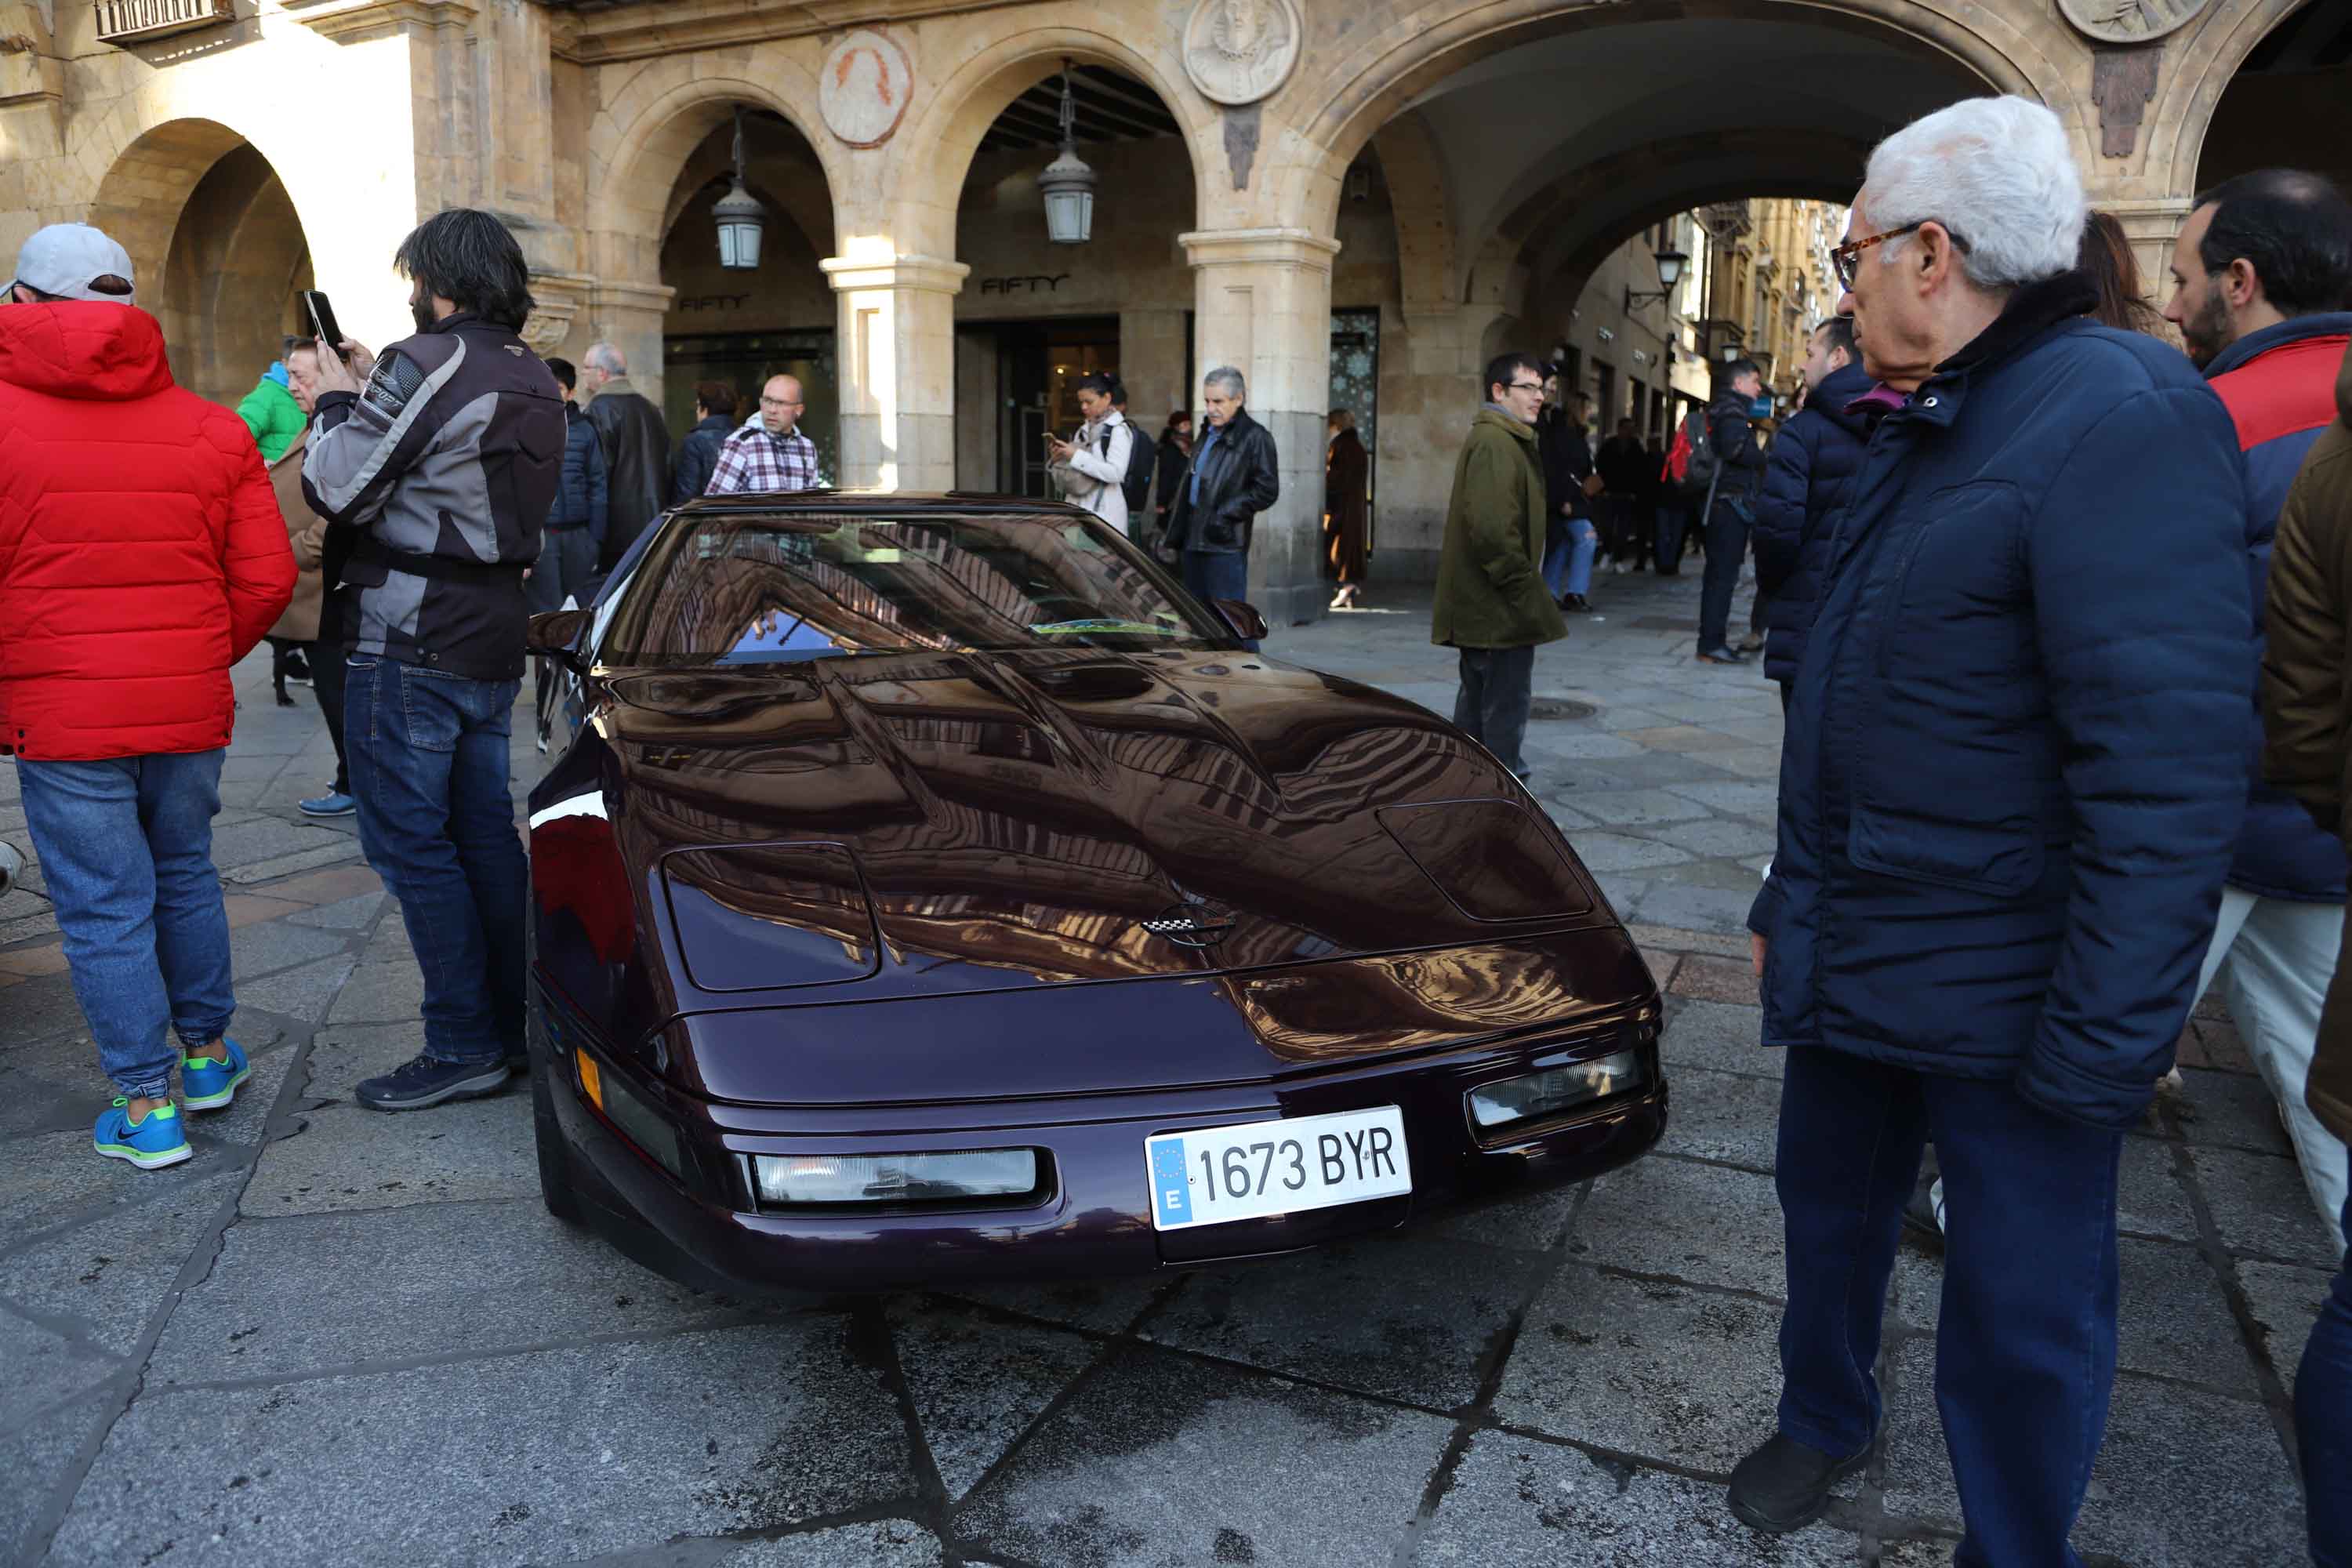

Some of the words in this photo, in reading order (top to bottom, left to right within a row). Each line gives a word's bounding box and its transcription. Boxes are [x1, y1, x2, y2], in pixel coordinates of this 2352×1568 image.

[980, 273, 1071, 296] FIFTY
[677, 292, 752, 312] FIFTY
[1200, 1139, 1307, 1202] 1673
[1318, 1127, 1396, 1185] BYR
[1166, 1189, 1183, 1210] E
